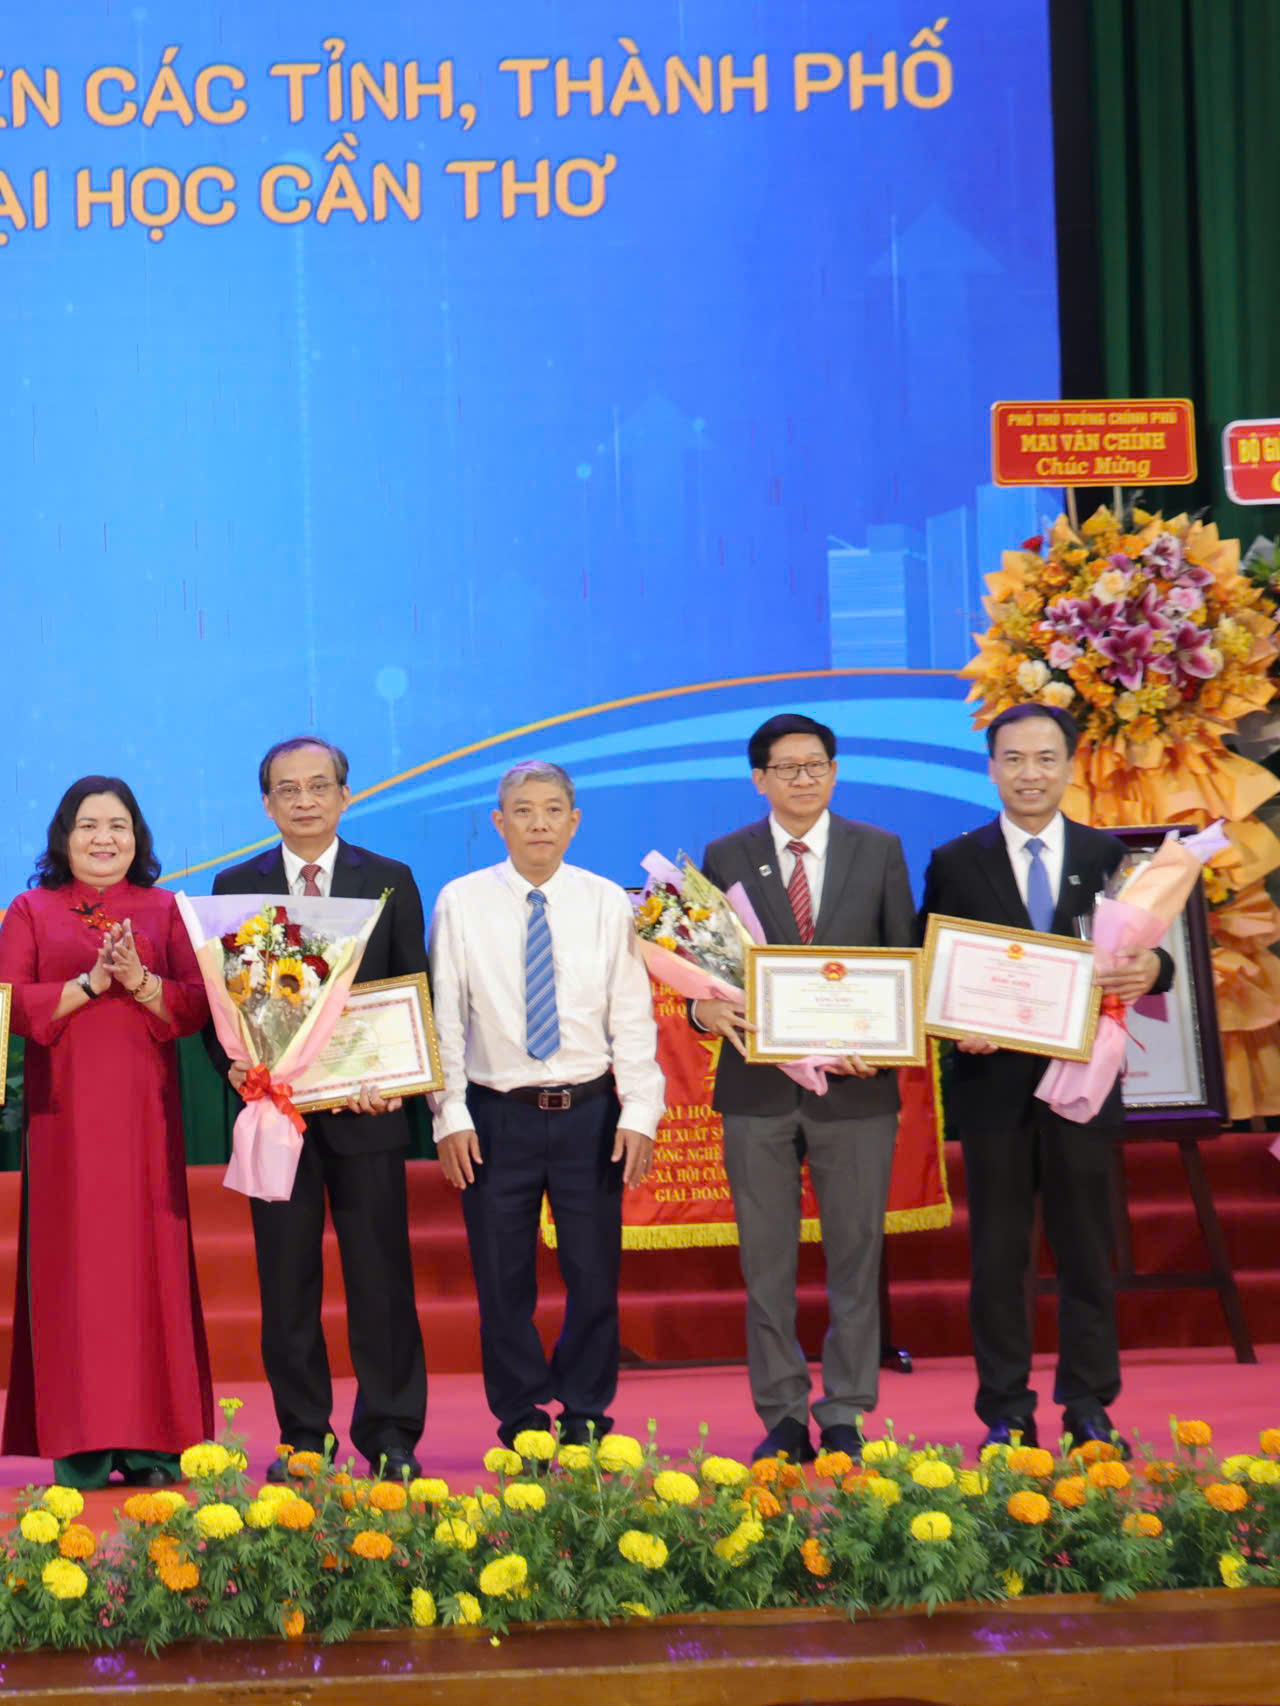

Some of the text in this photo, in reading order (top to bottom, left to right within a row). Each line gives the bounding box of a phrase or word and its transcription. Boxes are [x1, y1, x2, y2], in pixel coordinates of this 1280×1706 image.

[85, 47, 247, 126] CÁC
[271, 38, 476, 129] TỈNH,
[499, 37, 768, 117] THÀNH
[794, 18, 953, 113] PHỐ
[77, 166, 236, 241] HỌC
[260, 132, 421, 223] CẦN
[445, 154, 617, 219] THƠ
[1021, 426, 1166, 453] MAI VĂN CHÍNH
[1036, 455, 1151, 478] Chúc Mừng
[655, 1188, 687, 1202] GIAI
